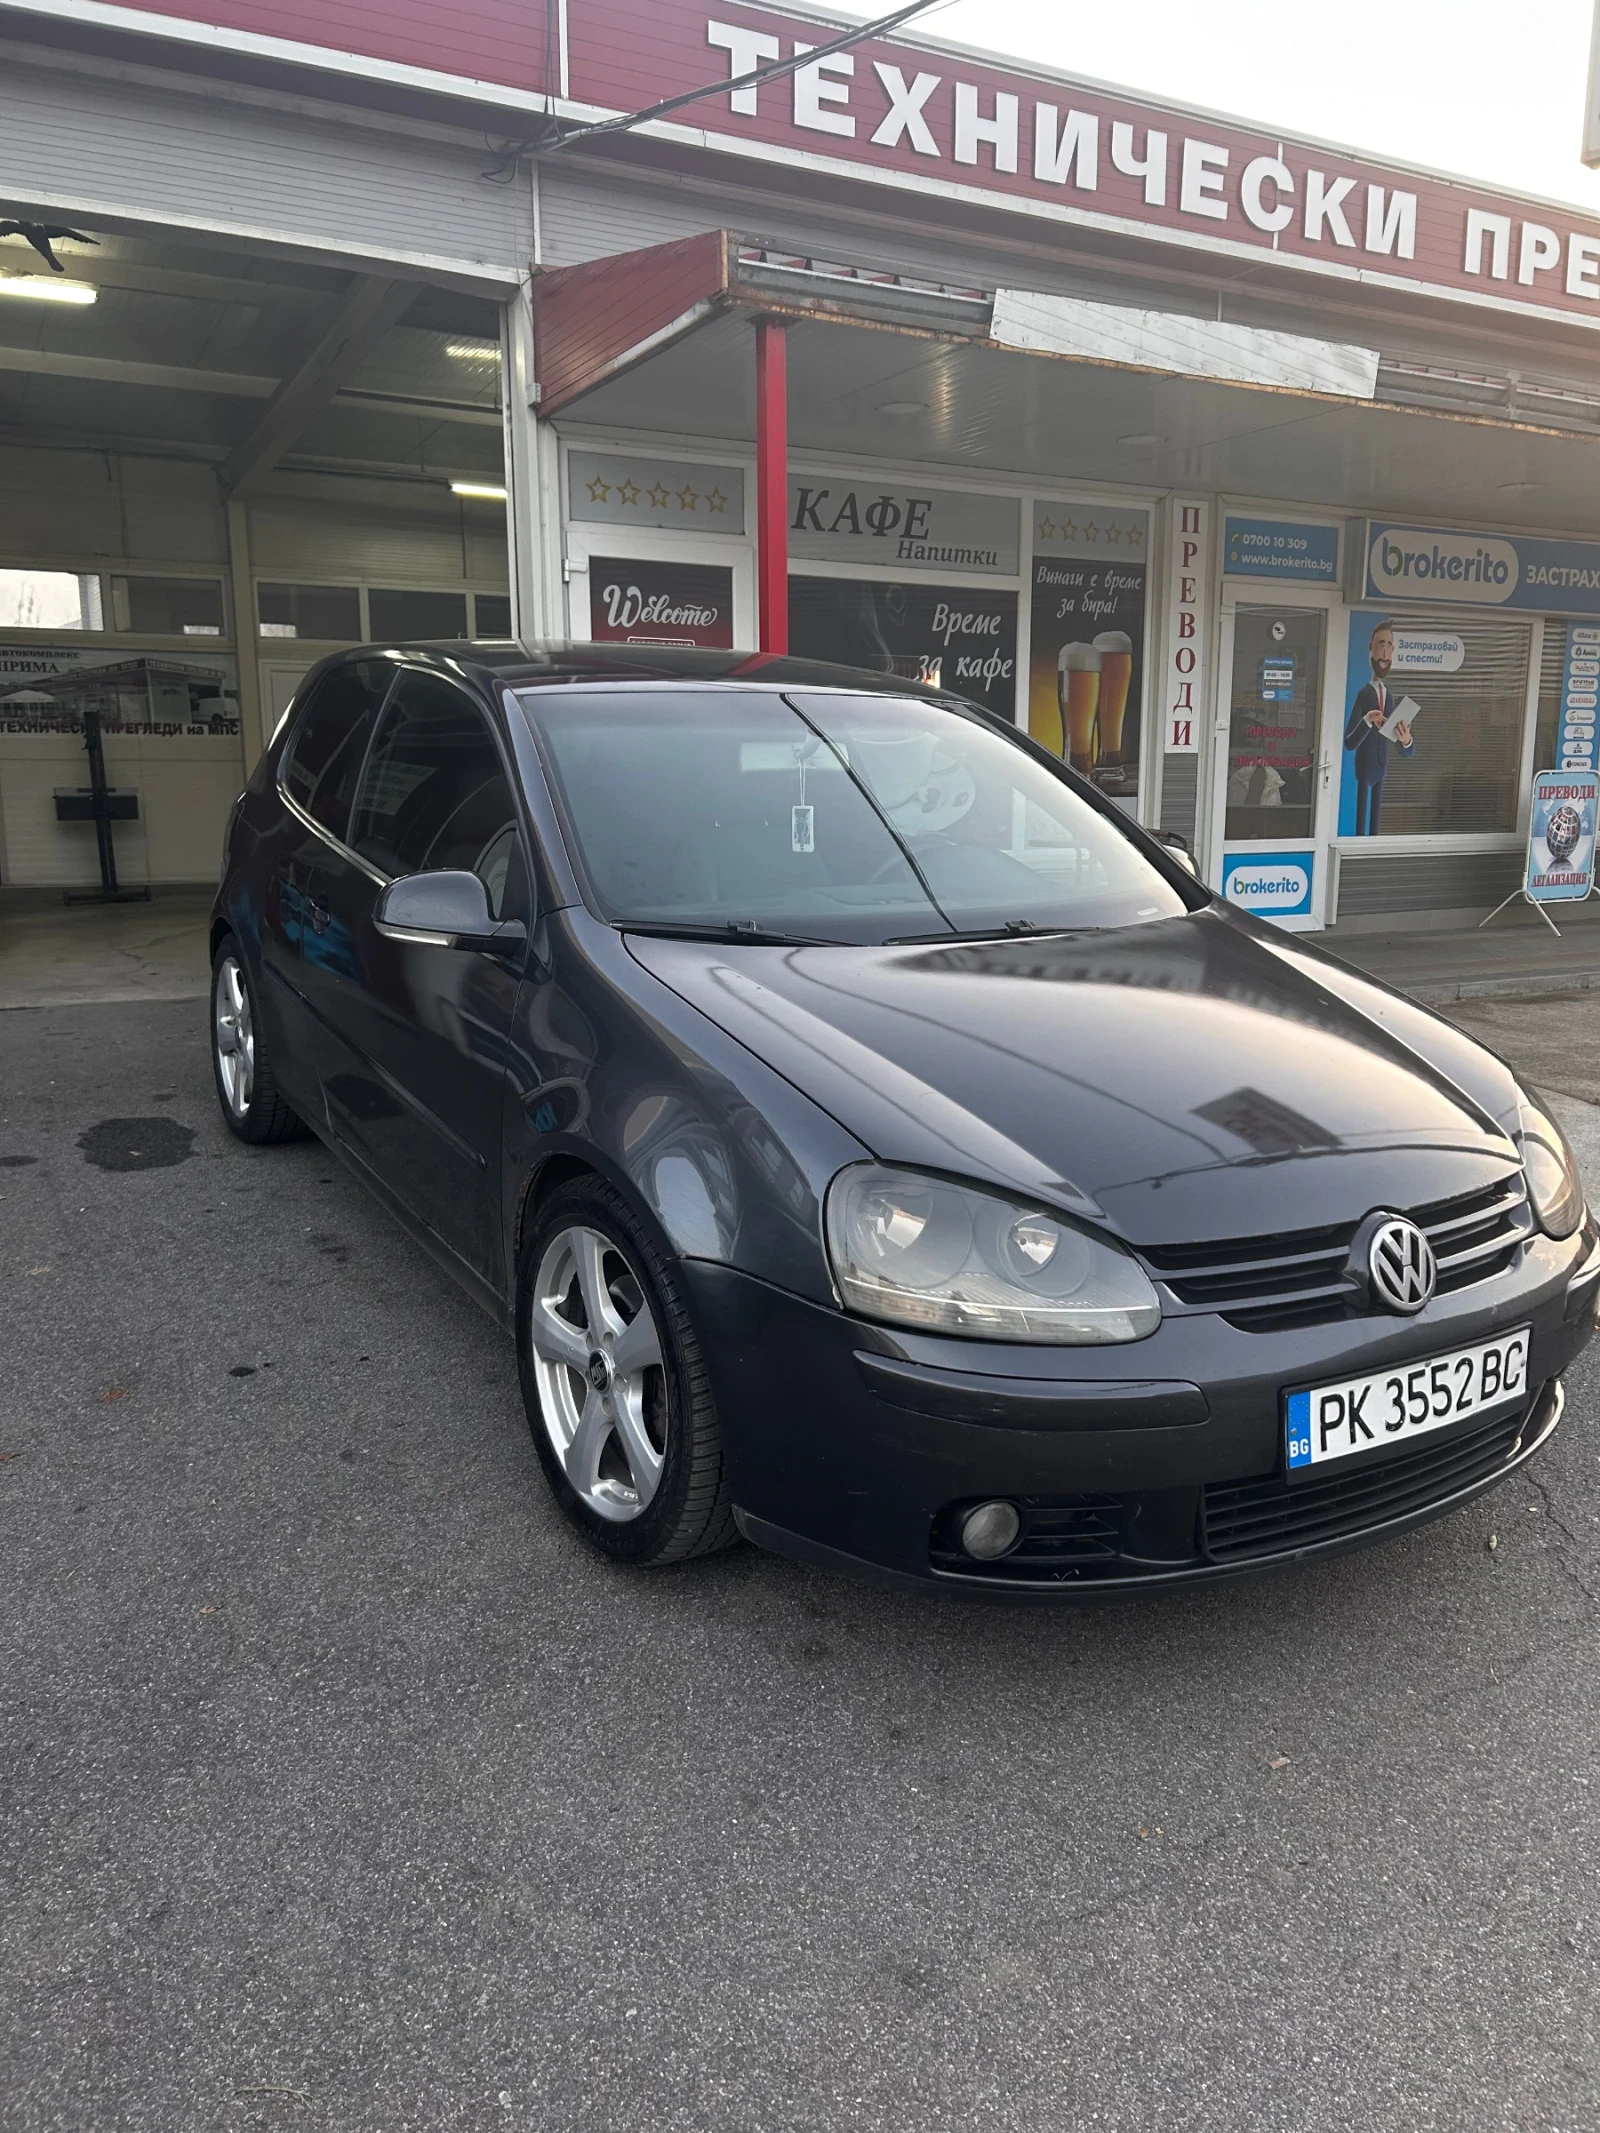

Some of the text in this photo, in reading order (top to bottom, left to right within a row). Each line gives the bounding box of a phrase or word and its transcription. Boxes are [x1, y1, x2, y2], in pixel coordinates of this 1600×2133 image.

[708, 20, 1600, 300] ТЕХНИЧЕСКИ ПРЕ
[790, 487, 932, 540] КАФЕ
[896, 539, 998, 566] Напитки
[1242, 533, 1308, 550] 0700 10 309
[1241, 553, 1333, 573] www.brokerito.bg
[1381, 536, 1509, 584] brokerito
[1036, 566, 1142, 596] Винаги е време
[1526, 564, 1600, 589] ЗАСТРАХ
[603, 584, 718, 628] Welcome
[1057, 589, 1119, 621] за бира!
[932, 603, 1002, 647] Време
[1171, 505, 1202, 746] ПРЕВОДИ
[0, 650, 81, 659] втокомплекс
[1398, 639, 1458, 652] Застраховай
[914, 647, 1013, 692] за кафе
[1397, 654, 1443, 664] и спести!
[1247, 726, 1297, 739] ПРЕВОДИ
[1538, 785, 1595, 803] ПРЕВОДИ
[1234, 877, 1300, 894] brokerito
[1531, 872, 1587, 888] ЛЕГАЛИЗАЦИЯ
[1320, 1340, 1523, 1452] PK 3552 BC
[1289, 1438, 1309, 1458] BG
